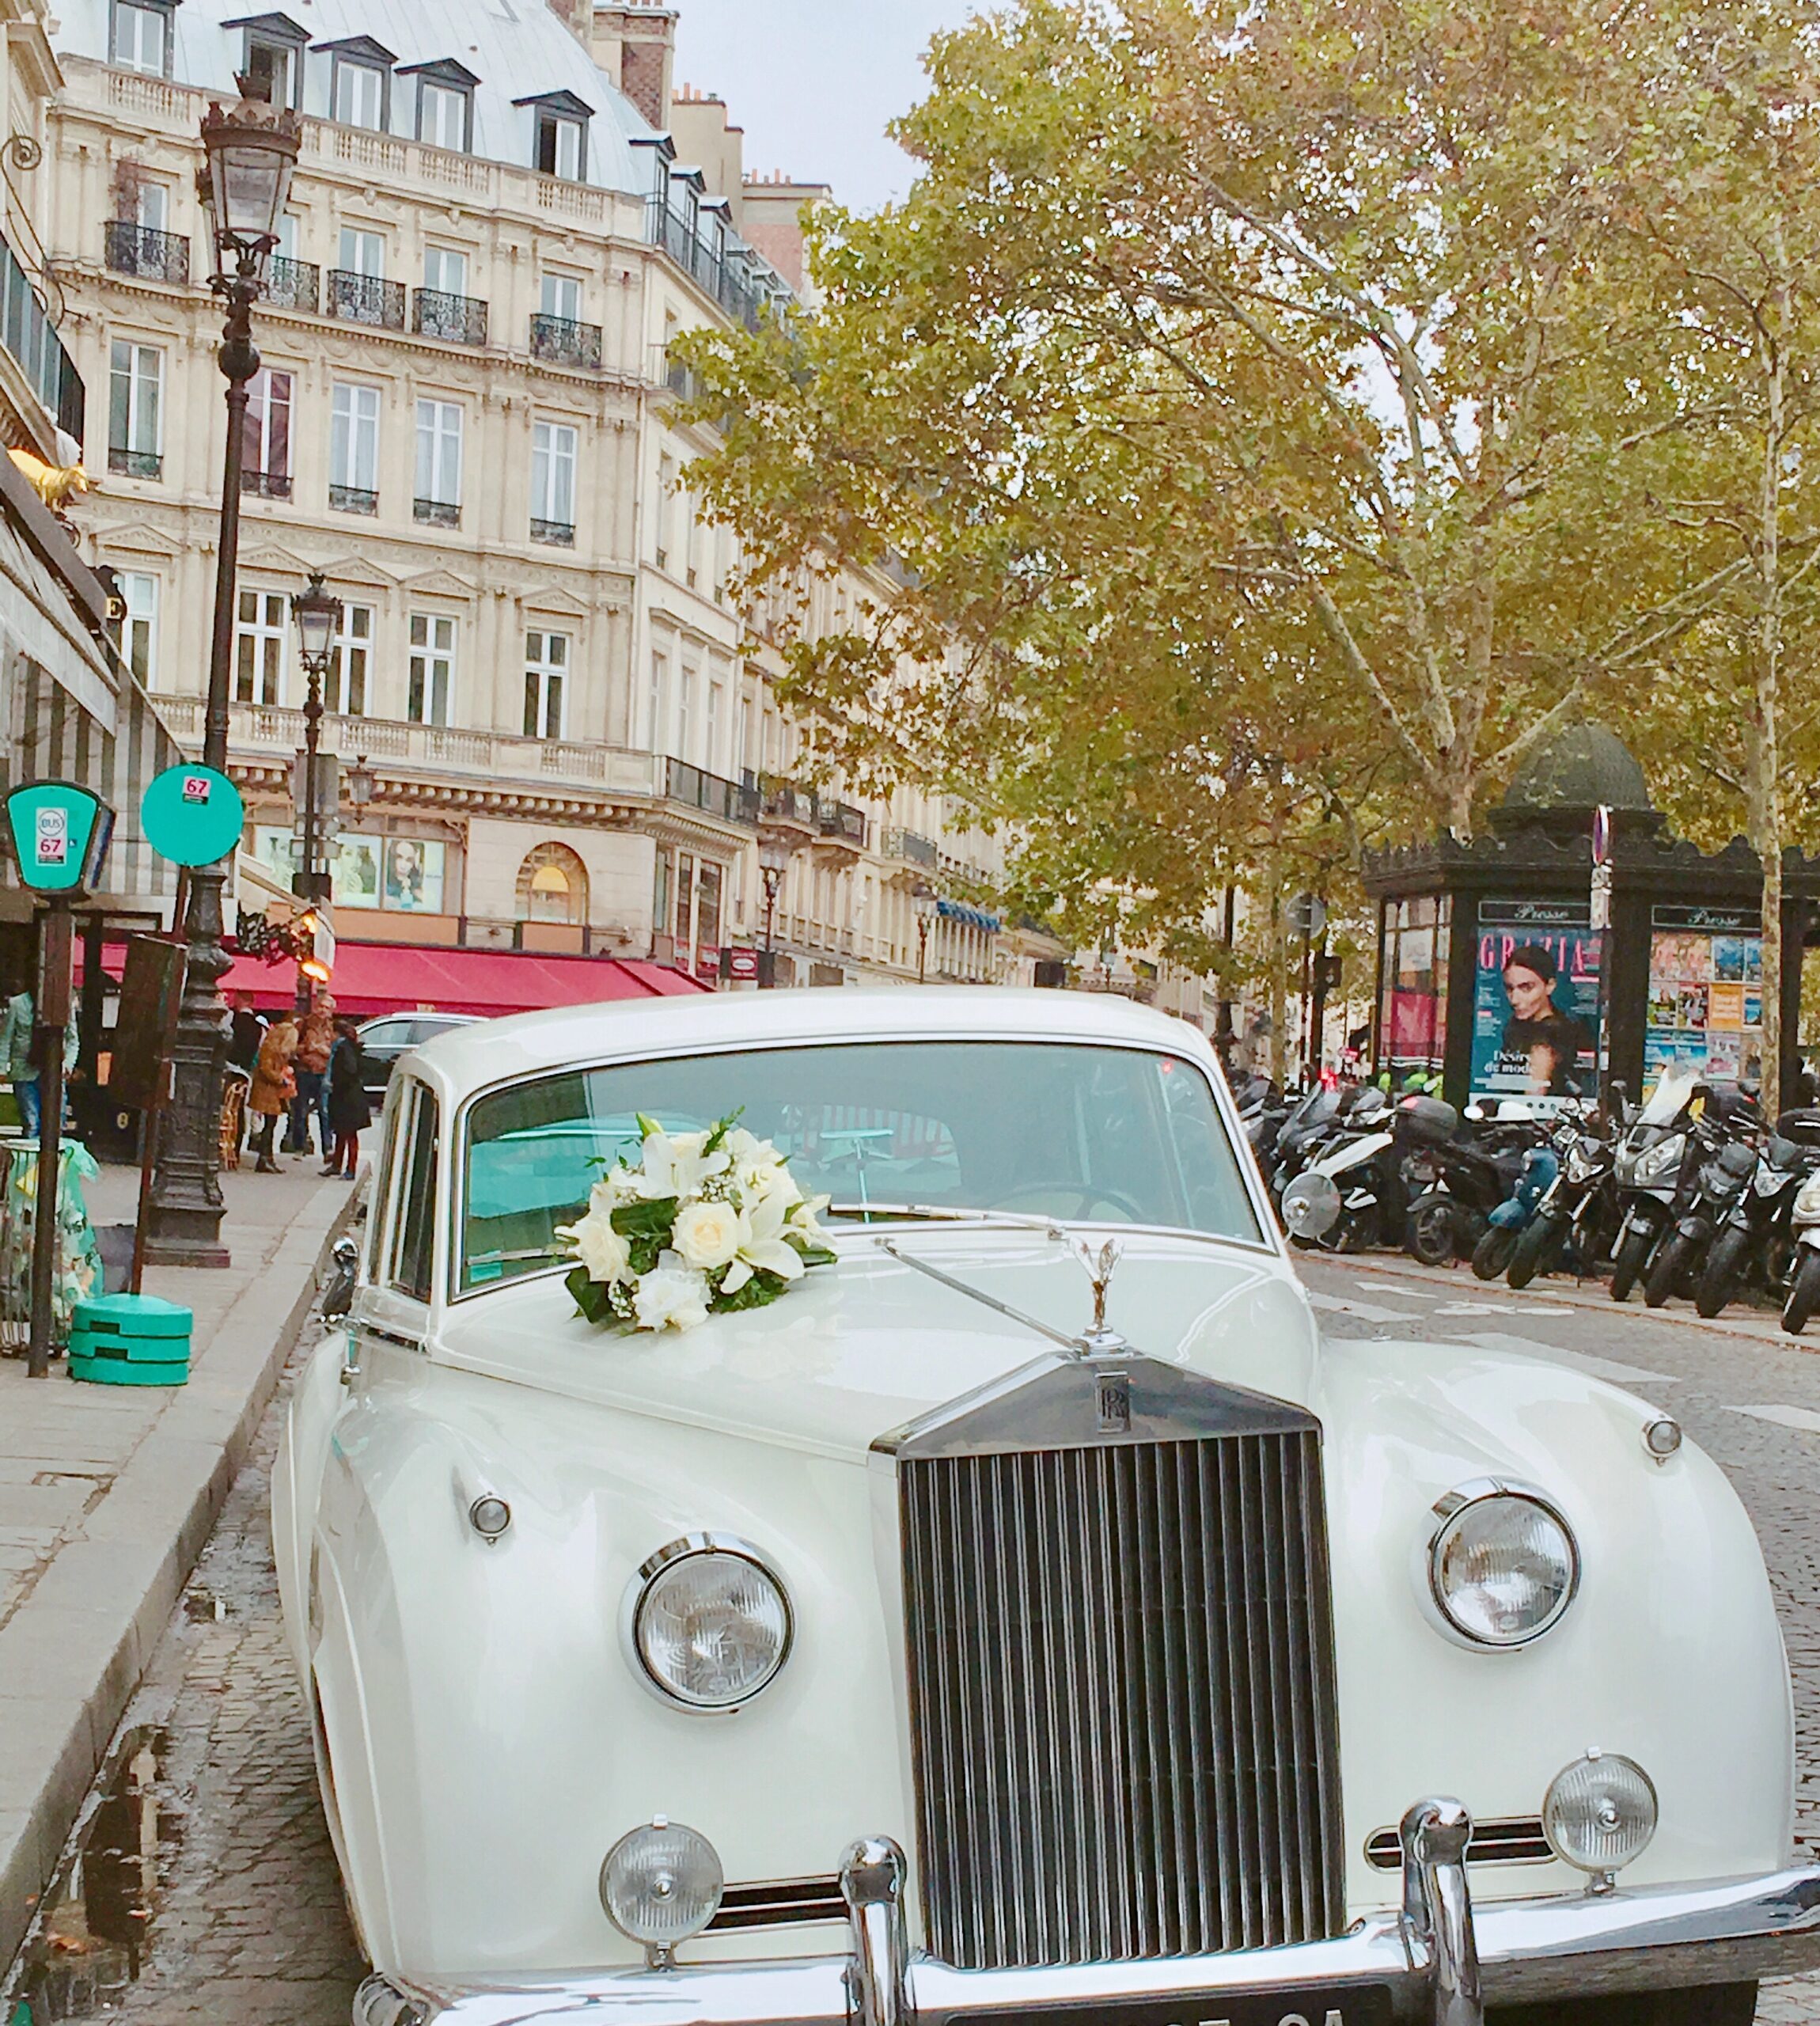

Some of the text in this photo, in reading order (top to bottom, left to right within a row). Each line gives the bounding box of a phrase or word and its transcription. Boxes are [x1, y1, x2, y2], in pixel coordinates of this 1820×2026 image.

[187, 779, 207, 794] 67
[42, 818, 60, 828] BUS
[40, 838, 61, 852] 67
[1514, 905, 1568, 919] Presse
[1481, 933, 1583, 973] GRIA
[1484, 1060, 1500, 1072] de
